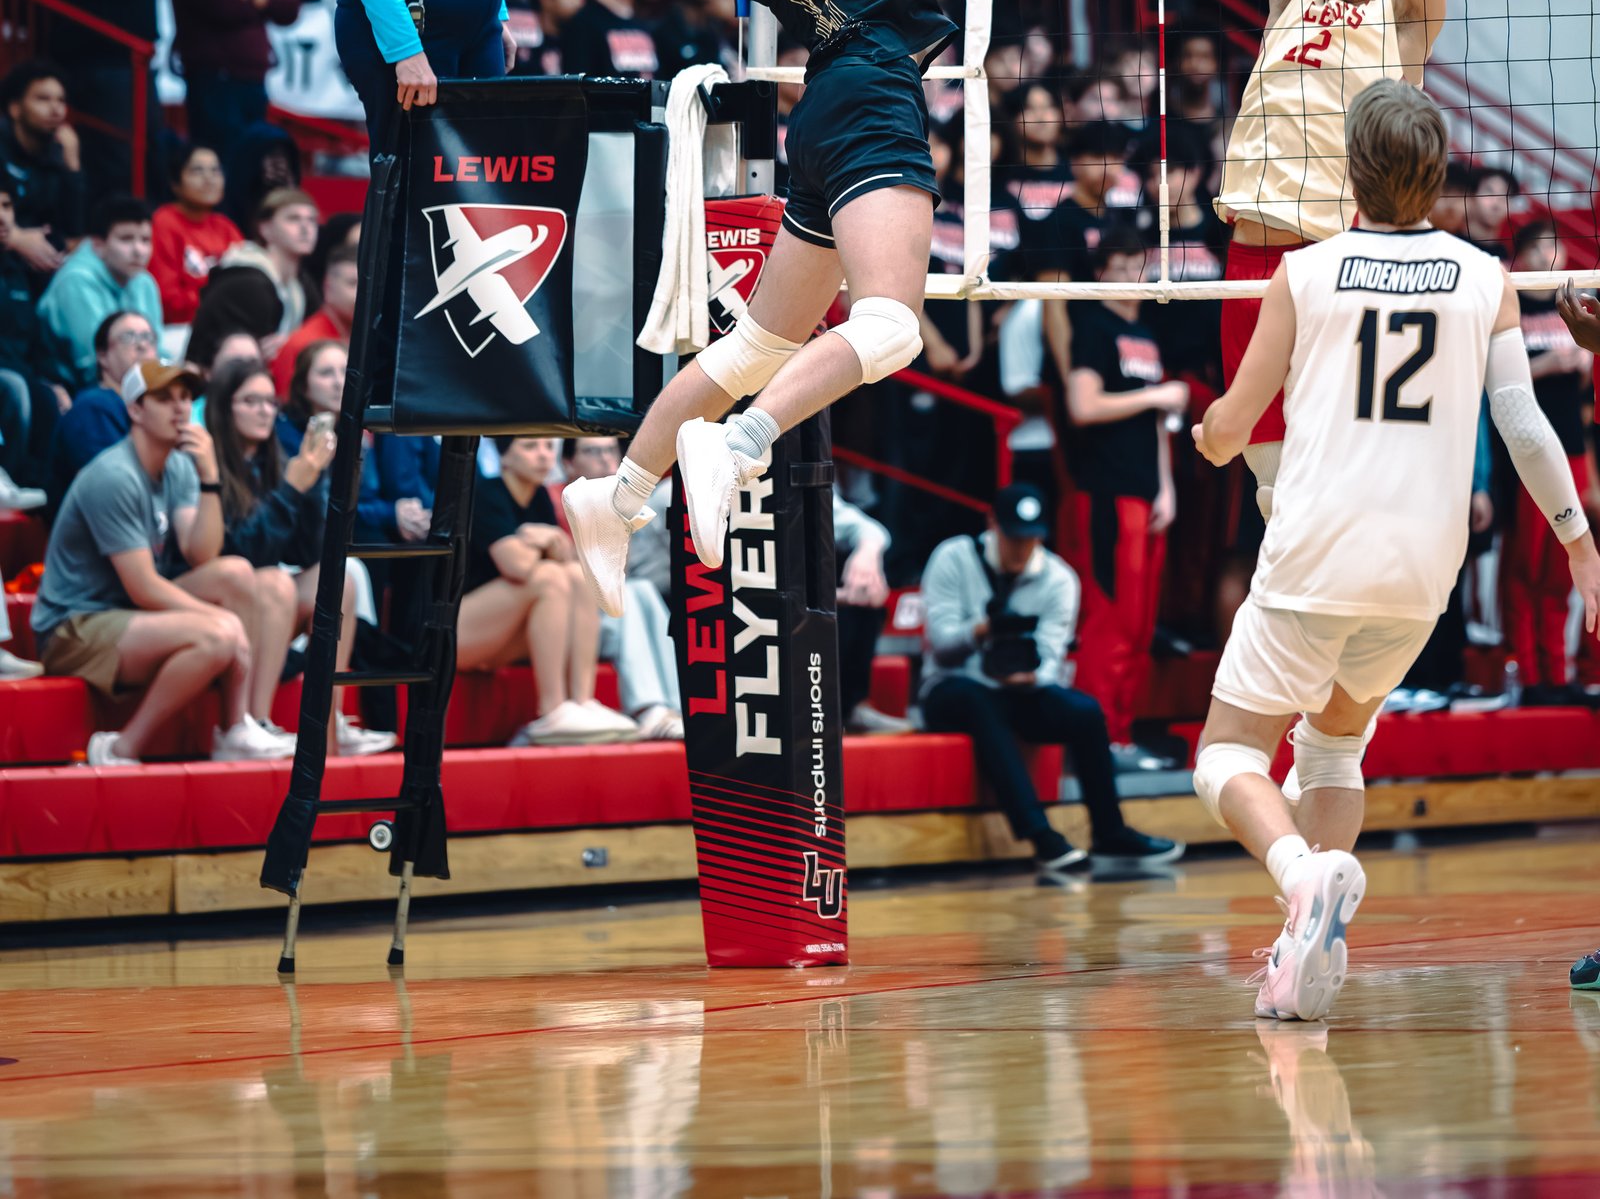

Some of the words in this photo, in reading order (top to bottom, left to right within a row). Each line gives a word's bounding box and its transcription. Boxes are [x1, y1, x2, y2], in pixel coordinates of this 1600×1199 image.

[1282, 29, 1332, 68] 12
[433, 155, 556, 183] LEWIS
[706, 228, 761, 249] EWIS
[1337, 257, 1460, 294] LINDENWOOD
[1354, 307, 1438, 425] 12
[682, 480, 728, 717] LEW
[809, 652, 825, 733] sports
[811, 737, 827, 838] imports
